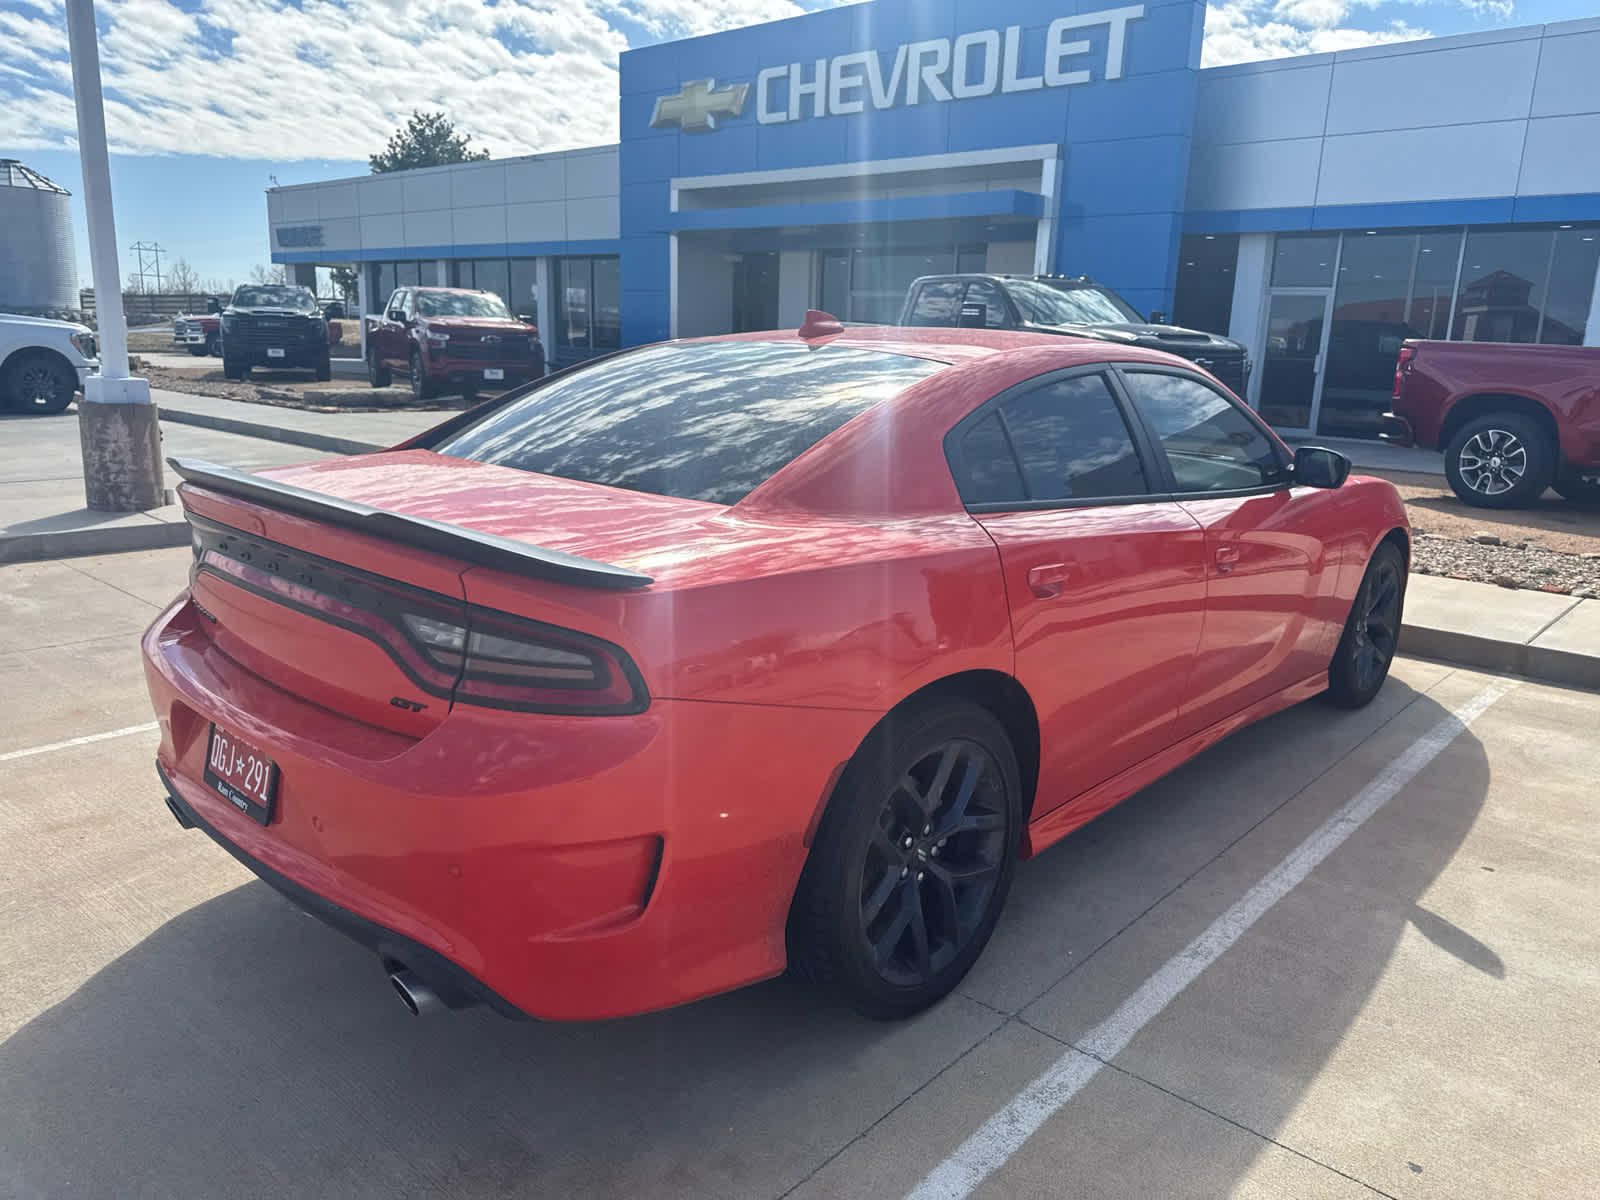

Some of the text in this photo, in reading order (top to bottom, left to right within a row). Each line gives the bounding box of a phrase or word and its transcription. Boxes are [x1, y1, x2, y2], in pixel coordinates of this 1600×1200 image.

[756, 4, 1144, 125] CHEVROLET
[390, 696, 428, 712] GT
[244, 755, 270, 801] 291
